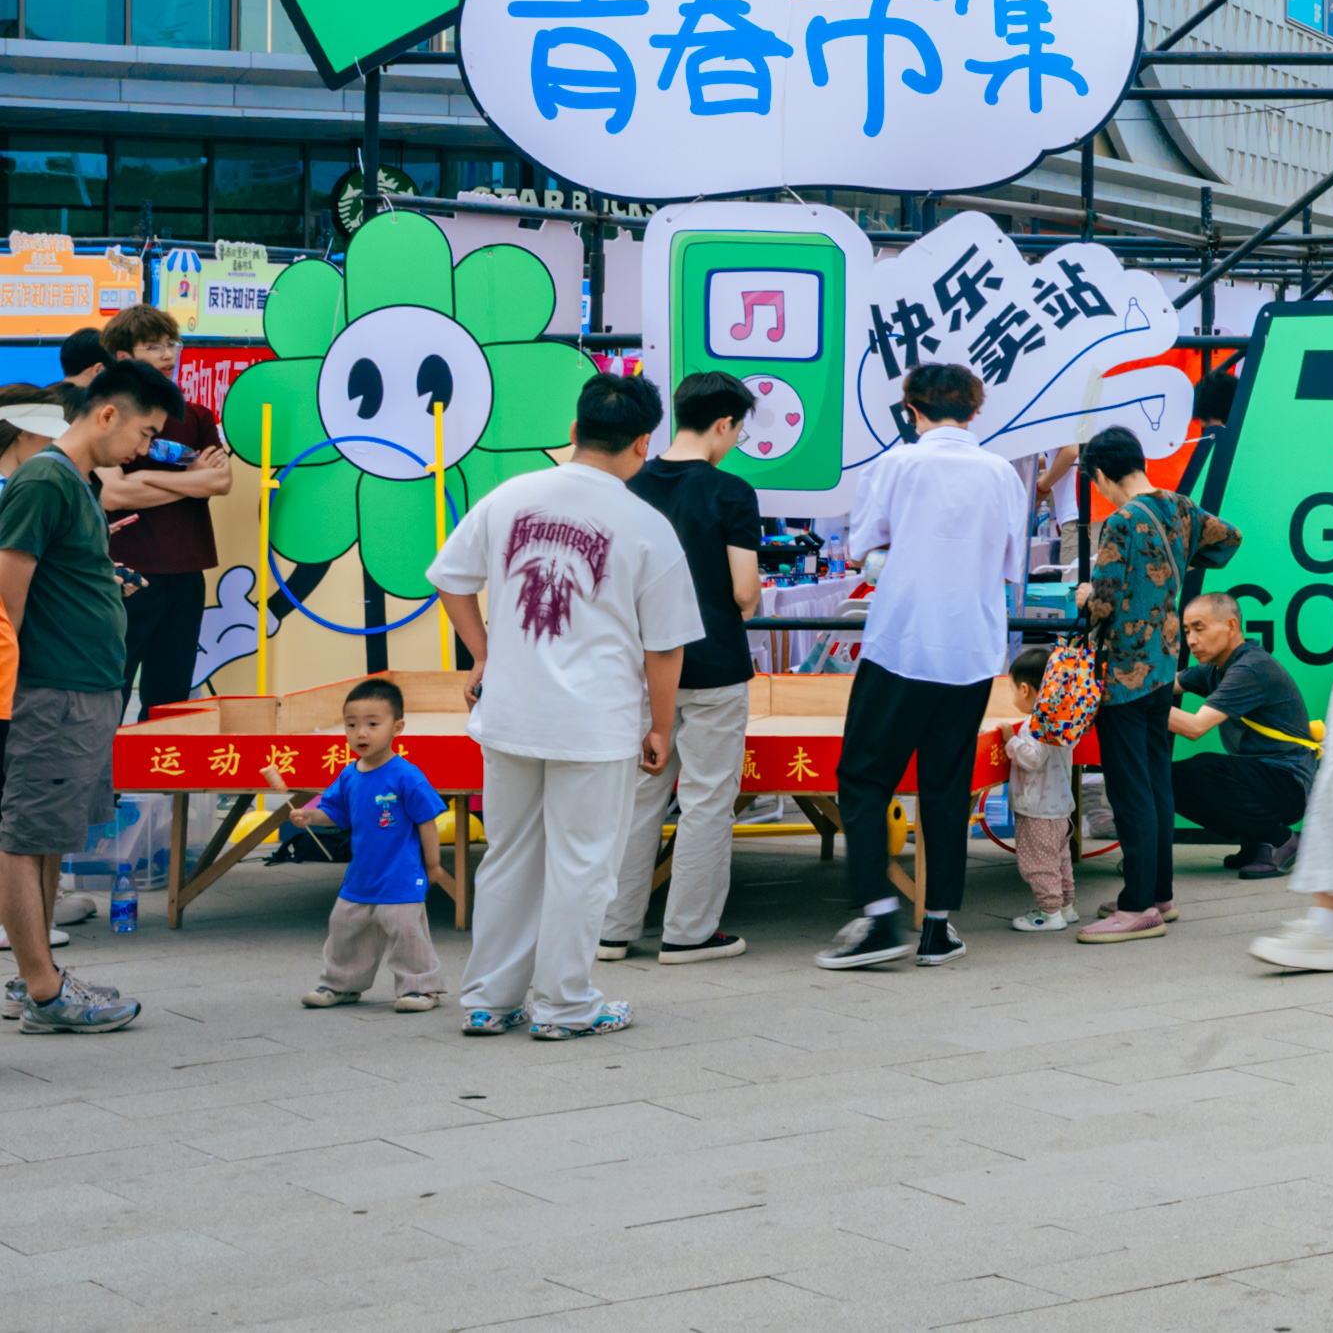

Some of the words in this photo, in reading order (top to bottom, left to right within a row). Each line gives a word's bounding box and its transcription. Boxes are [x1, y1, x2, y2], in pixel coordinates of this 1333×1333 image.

[1, 282, 90, 307] 反诈知识普及
[868, 243, 1004, 381] 快乐
